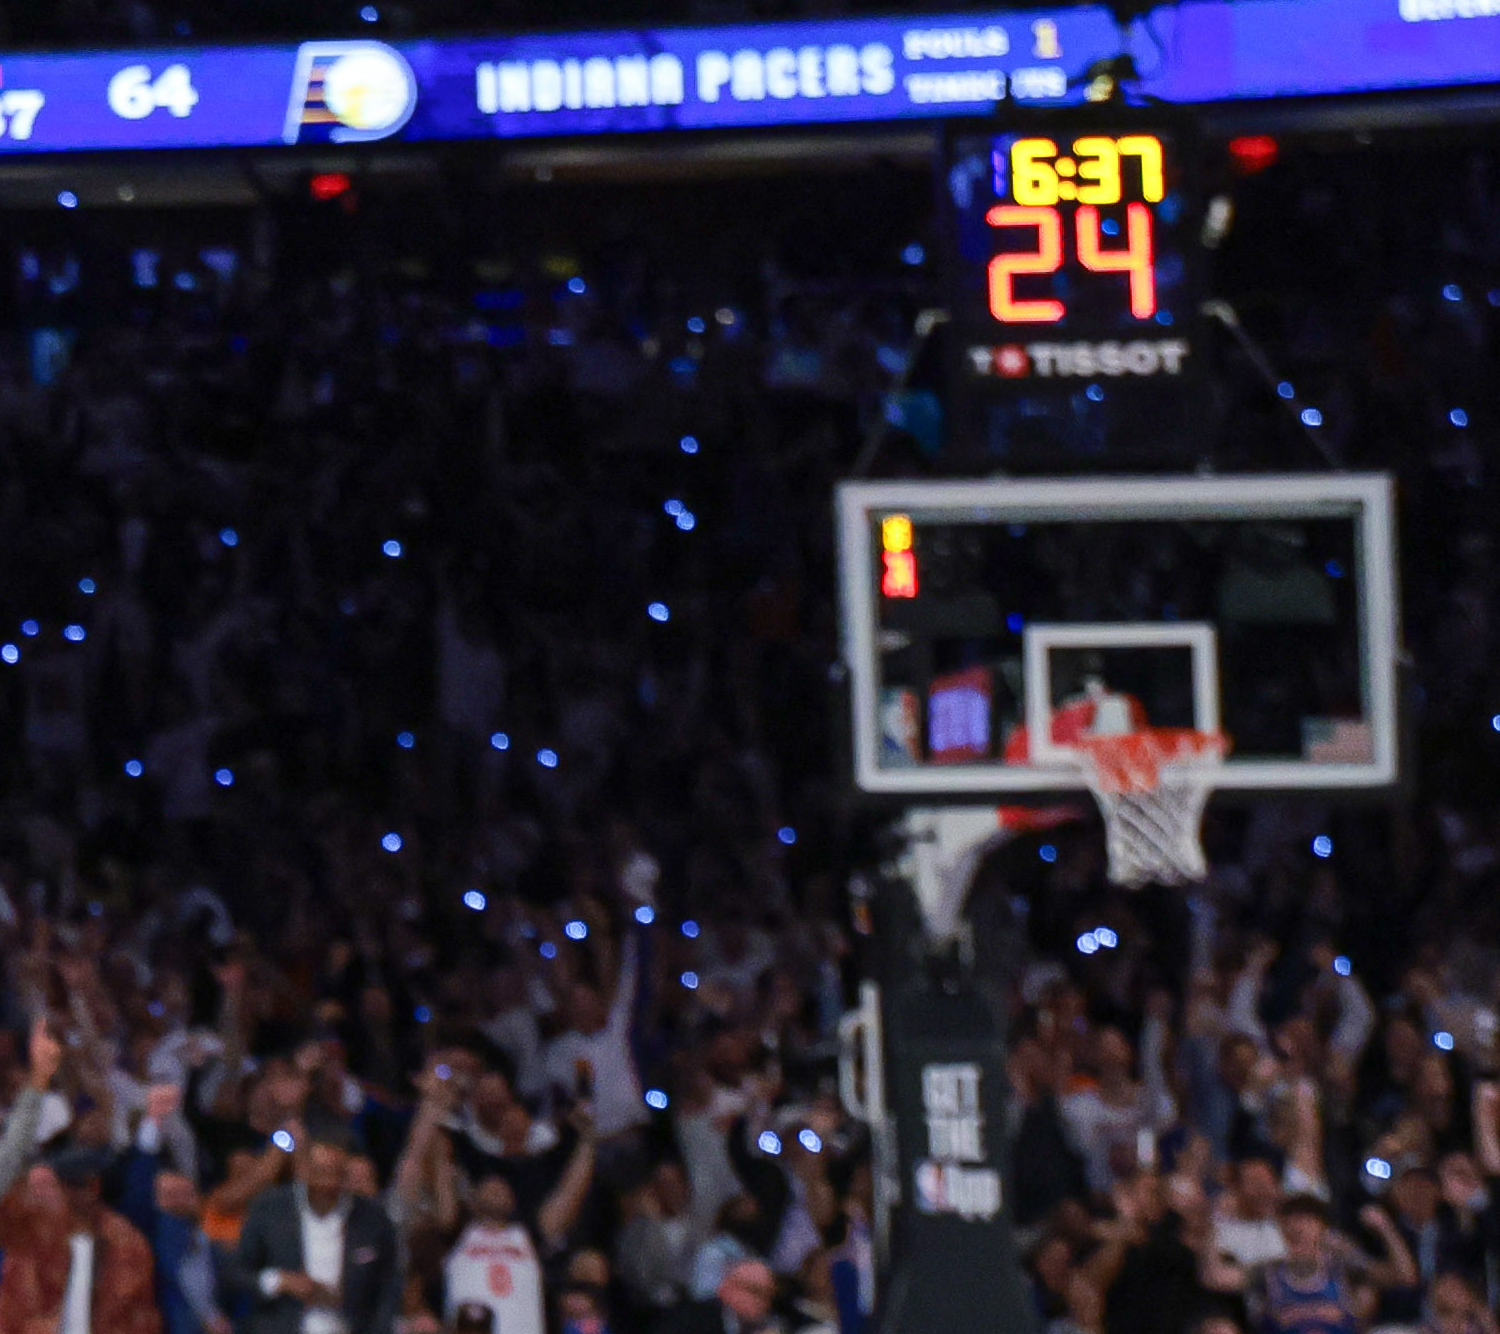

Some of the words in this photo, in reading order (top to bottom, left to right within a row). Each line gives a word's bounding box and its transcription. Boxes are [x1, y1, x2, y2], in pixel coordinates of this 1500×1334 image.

[106, 64, 198, 119] 64
[476, 51, 685, 114] INDIANA
[697, 42, 896, 103] PACERS
[1010, 135, 1165, 206] 6:37
[986, 201, 1157, 322] 24
[1027, 339, 1190, 377] TISSOT
